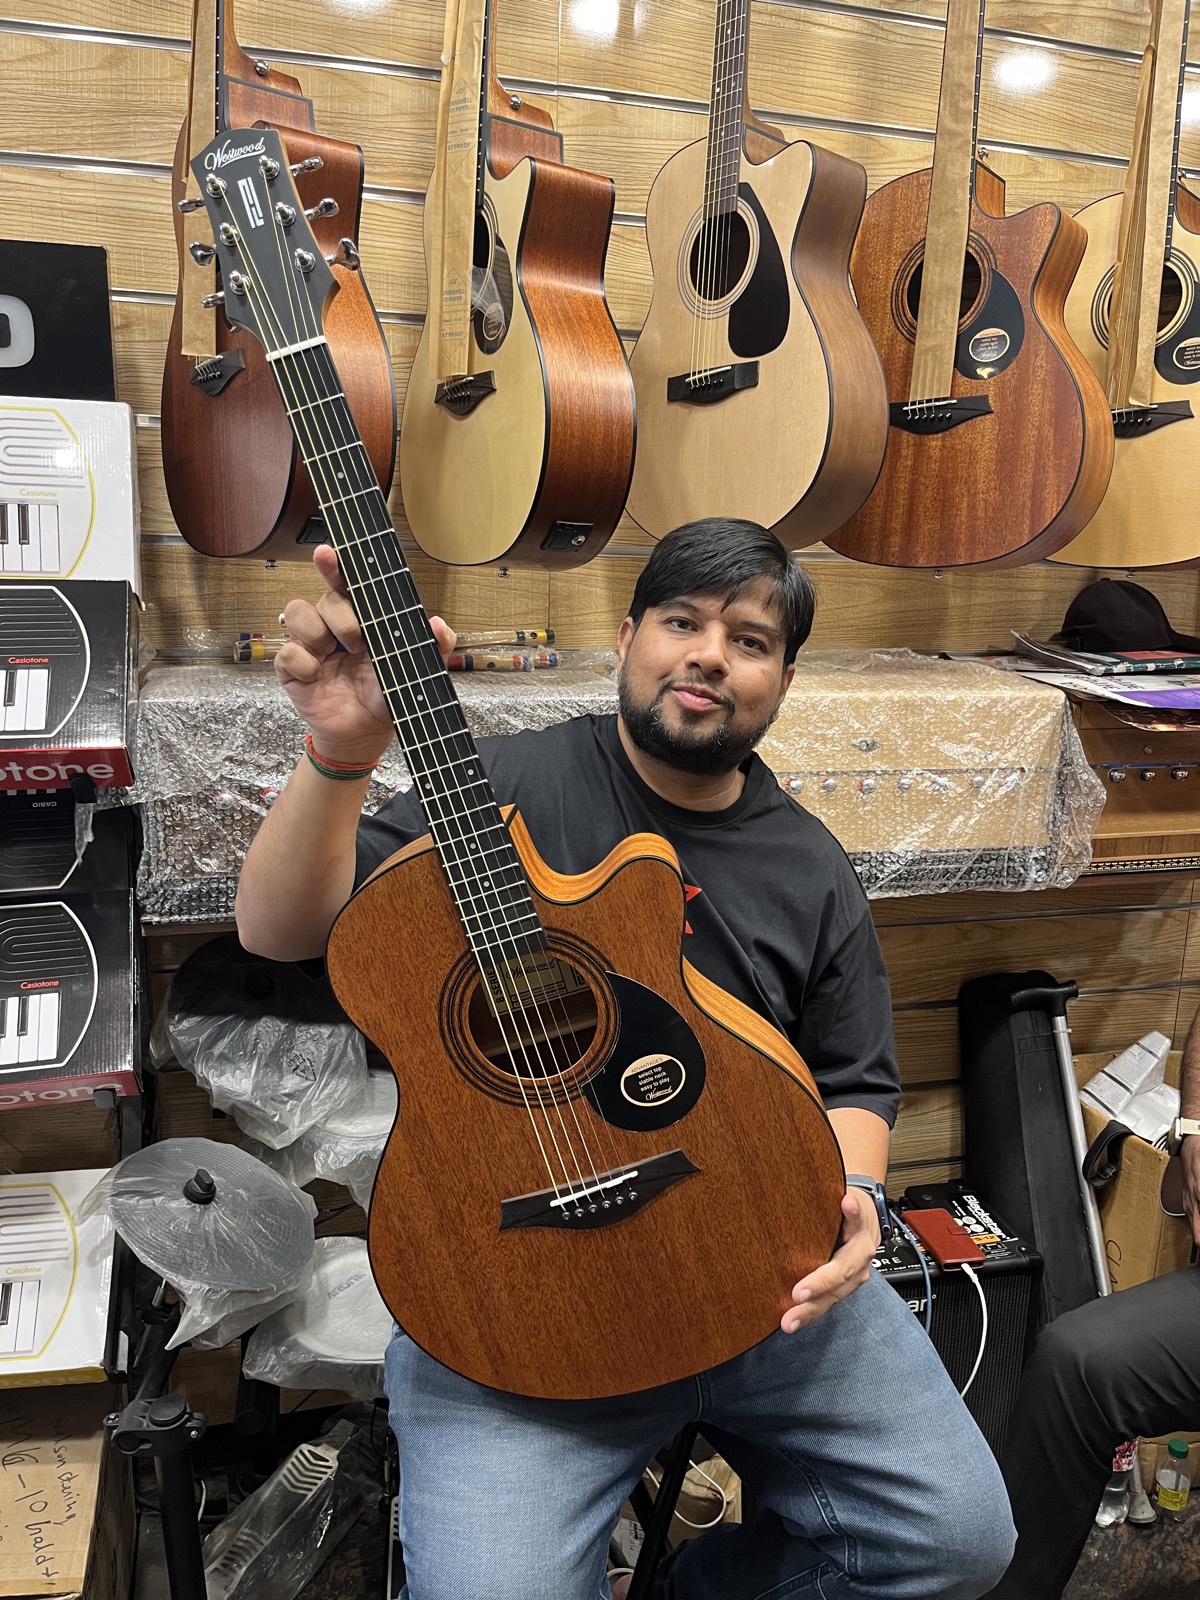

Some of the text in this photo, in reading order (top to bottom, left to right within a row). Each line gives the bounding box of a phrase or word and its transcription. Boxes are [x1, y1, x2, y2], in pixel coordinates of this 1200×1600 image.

[204, 137, 266, 171] Westwood
[20, 488, 58, 498] Casiotone
[8, 656, 49, 664] Casiotone
[0, 761, 115, 782] tone
[505, 957, 557, 980] Westwood
[20, 980, 59, 990] Casiotone
[631, 1057, 664, 1073] ADVANTAGES
[638, 1066, 662, 1079] select top
[638, 1071, 667, 1086] stable neck
[640, 1083, 653, 1092] easy
[659, 1077, 670, 1085] play
[962, 1195, 1007, 1239] Blackstar
[6, 1266, 42, 1275] Casiotone
